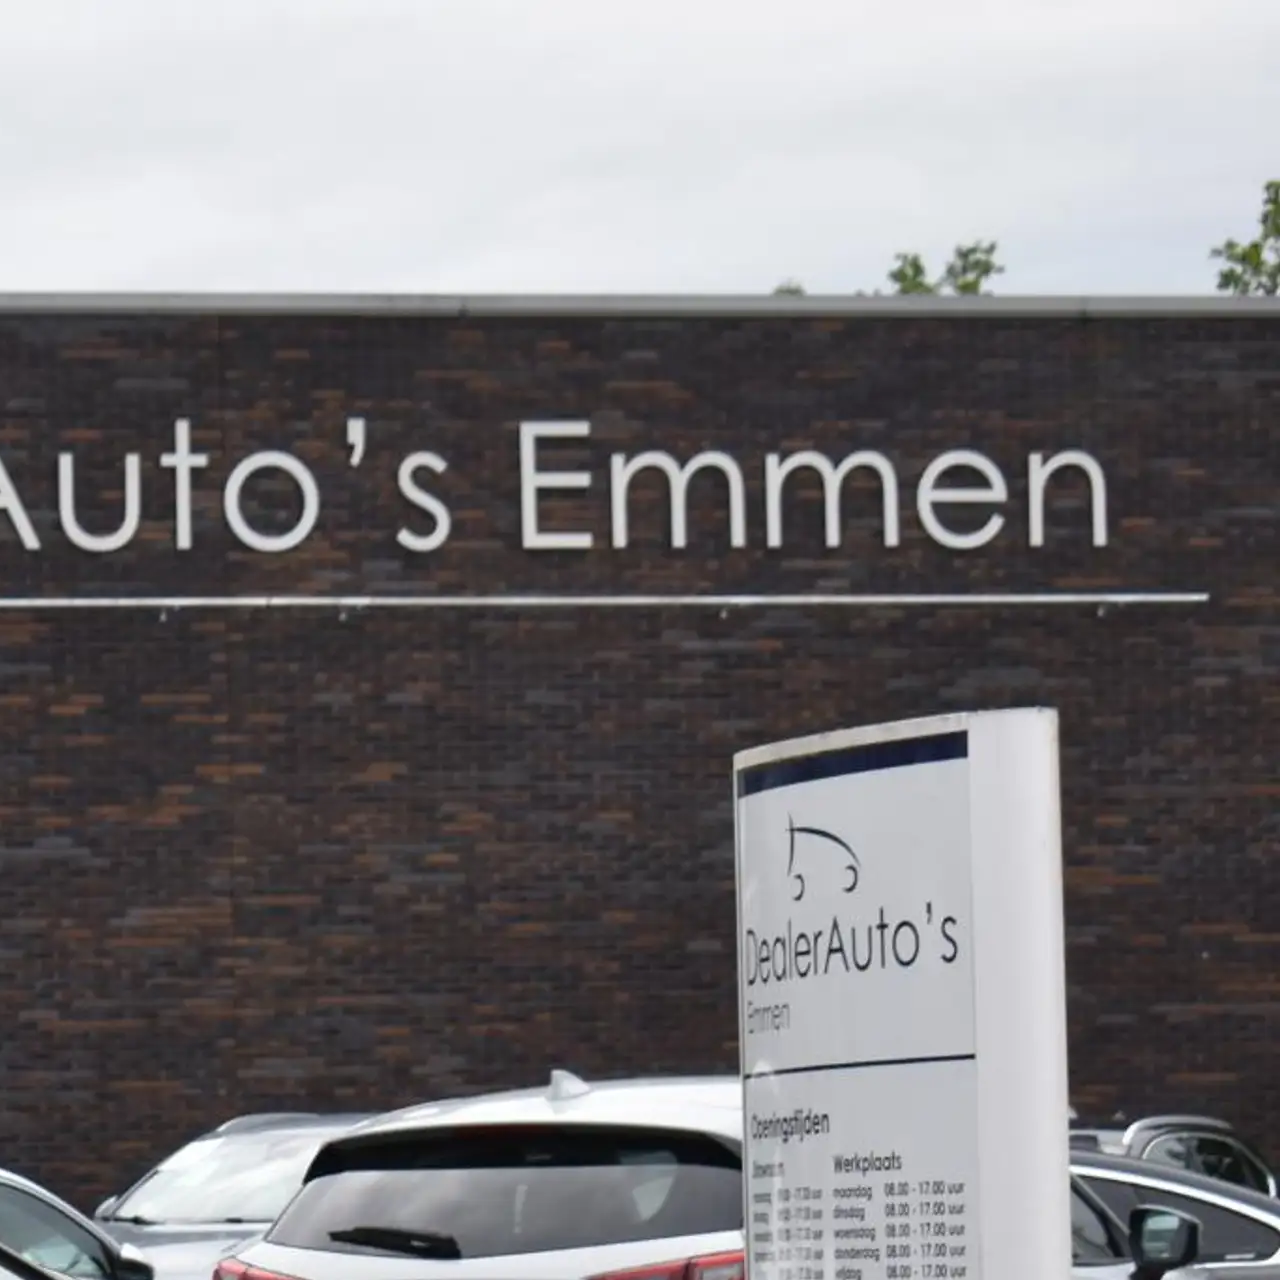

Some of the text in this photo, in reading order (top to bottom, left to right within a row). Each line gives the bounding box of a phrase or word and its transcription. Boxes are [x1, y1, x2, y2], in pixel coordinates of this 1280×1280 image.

[518, 421, 1108, 550] Emmen
[745, 901, 959, 986] DealerAuto's
[833, 1150, 902, 1177] Werkplaats
